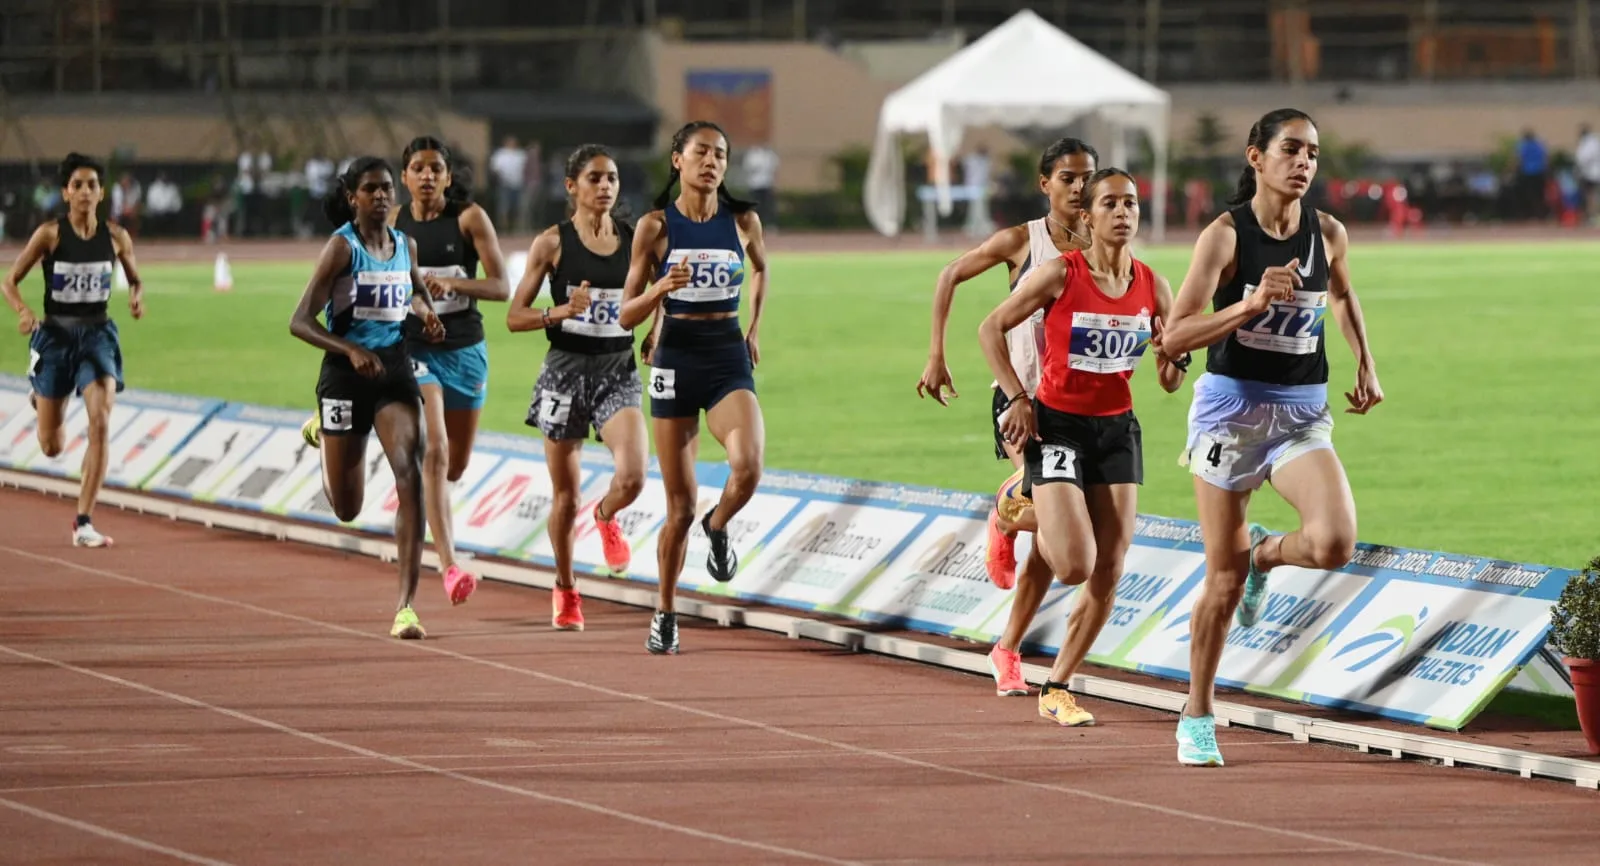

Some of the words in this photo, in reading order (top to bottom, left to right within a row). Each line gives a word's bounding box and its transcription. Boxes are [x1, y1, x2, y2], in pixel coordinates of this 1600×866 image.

[64, 274, 101, 294] 266
[370, 284, 406, 308] 119
[1252, 303, 1316, 338] 272
[1084, 329, 1138, 359] 300
[654, 376, 665, 394] 6
[330, 405, 343, 425] 3
[549, 398, 561, 417] 7
[1053, 450, 1067, 472] 2
[1206, 442, 1223, 468] 4
[800, 520, 881, 561] Reliance
[1147, 519, 1194, 542] National
[928, 541, 989, 582] Relian
[1350, 547, 1398, 569] petition
[1394, 551, 1432, 576] 2026,
[1425, 555, 1479, 582] Ranchi,
[1472, 560, 1554, 588] Jharkhand
[1422, 620, 1520, 659] INDIAN
[1397, 654, 1485, 685] ATHLETICS
